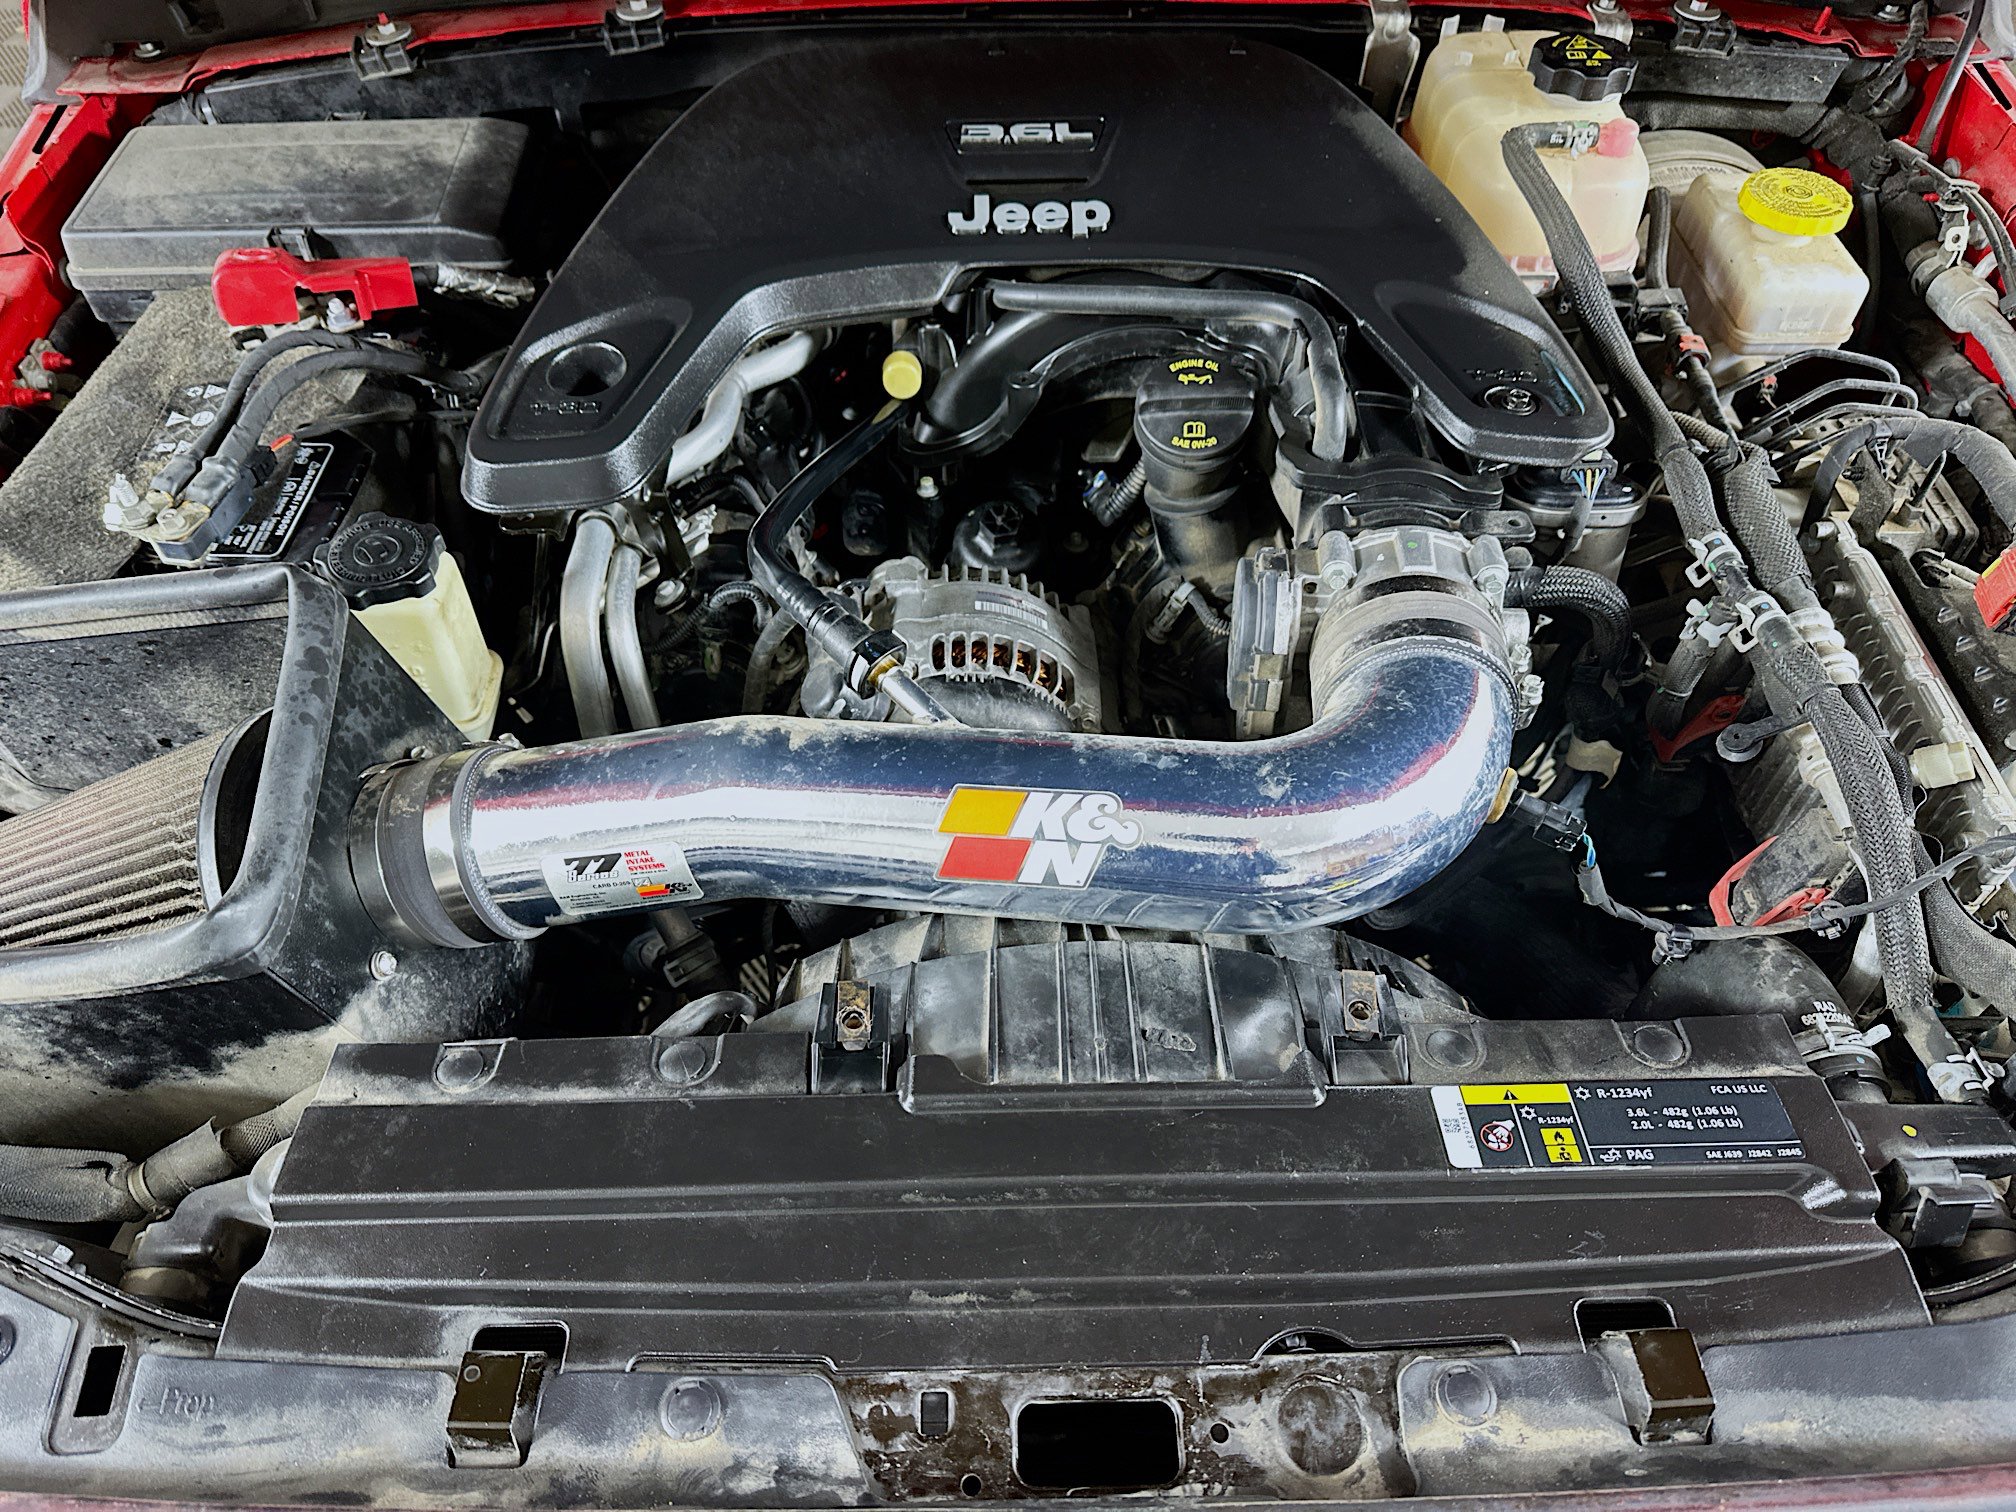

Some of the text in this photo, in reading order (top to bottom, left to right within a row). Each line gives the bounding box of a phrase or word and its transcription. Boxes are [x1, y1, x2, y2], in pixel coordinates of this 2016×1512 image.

[960, 122, 1094, 145] 3.6L
[947, 194, 1111, 239] Jeep
[1168, 359, 1219, 373] ENGINE OIL
[1171, 436, 1218, 450] SAE 0W-20
[623, 850, 650, 858] METAL
[626, 857, 656, 865] INTAKE
[628, 863, 666, 872] SYSTEMS
[1812, 1001, 1838, 1012] RAD
[1597, 1087, 1652, 1099] R-1234yf
[1710, 1084, 1768, 1094] FCA US LLC
[1626, 1108, 1650, 1117] 3.6L
[1662, 1107, 1689, 1118] 482g
[1692, 1106, 1719, 1117] (1.06
[1720, 1105, 1738, 1116] Lb)
[1537, 1116, 1574, 1125] R-1234yf
[1631, 1120, 1655, 1130] 2.0L
[1667, 1120, 1694, 1130] 482g
[1697, 1119, 1724, 1130] (1.06
[1725, 1118, 1744, 1129] Lb)
[1626, 1149, 1655, 1161] PAG
[1705, 1151, 1723, 1159] SAE
[1723, 1150, 1743, 1159] J639
